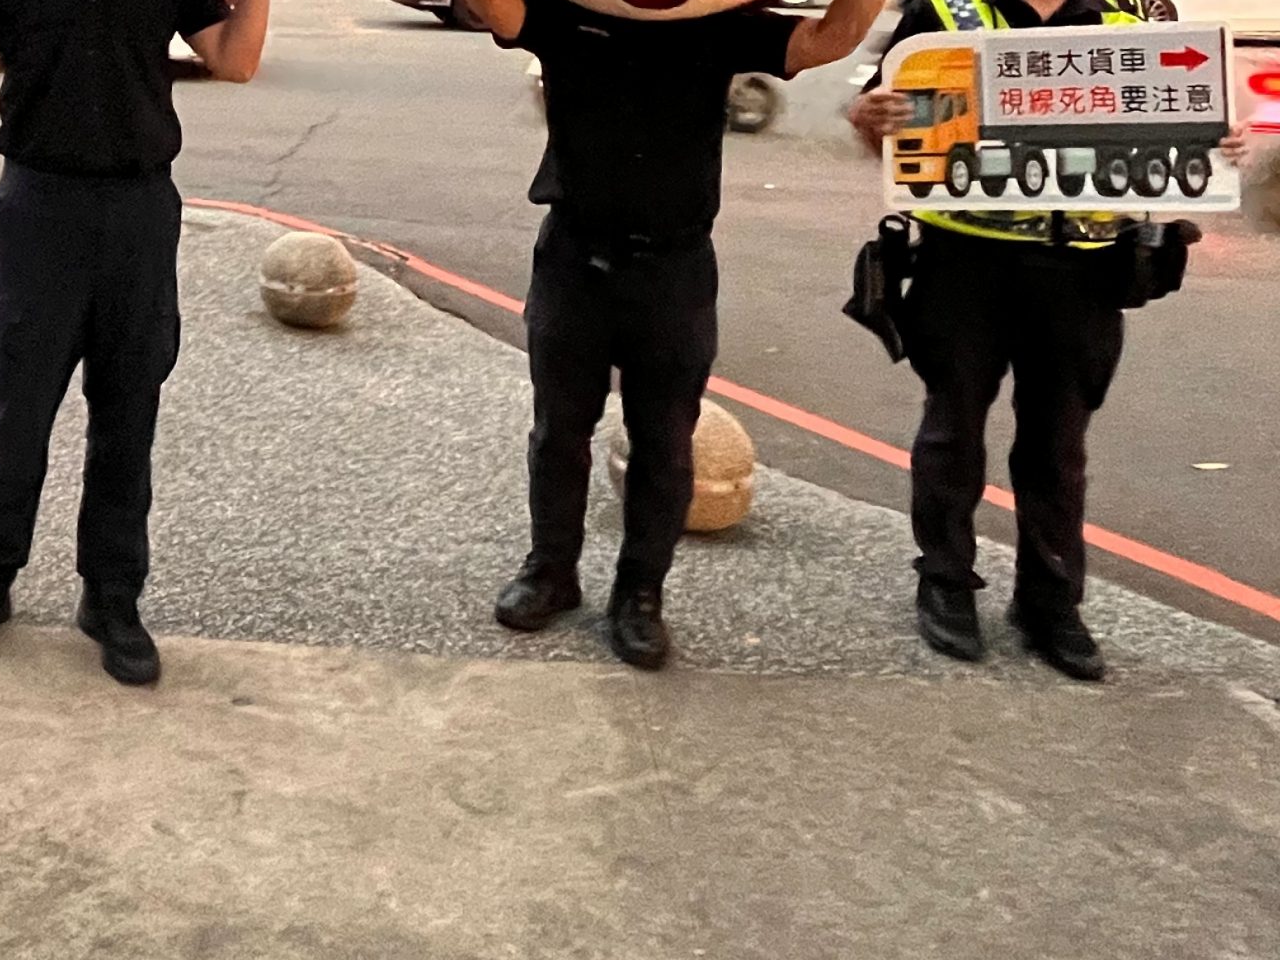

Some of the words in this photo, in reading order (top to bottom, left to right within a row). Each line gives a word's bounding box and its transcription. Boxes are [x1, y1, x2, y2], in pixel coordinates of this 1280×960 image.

[995, 47, 1147, 79] 遠離大貨車
[998, 84, 1214, 116] 視線死角要注意
